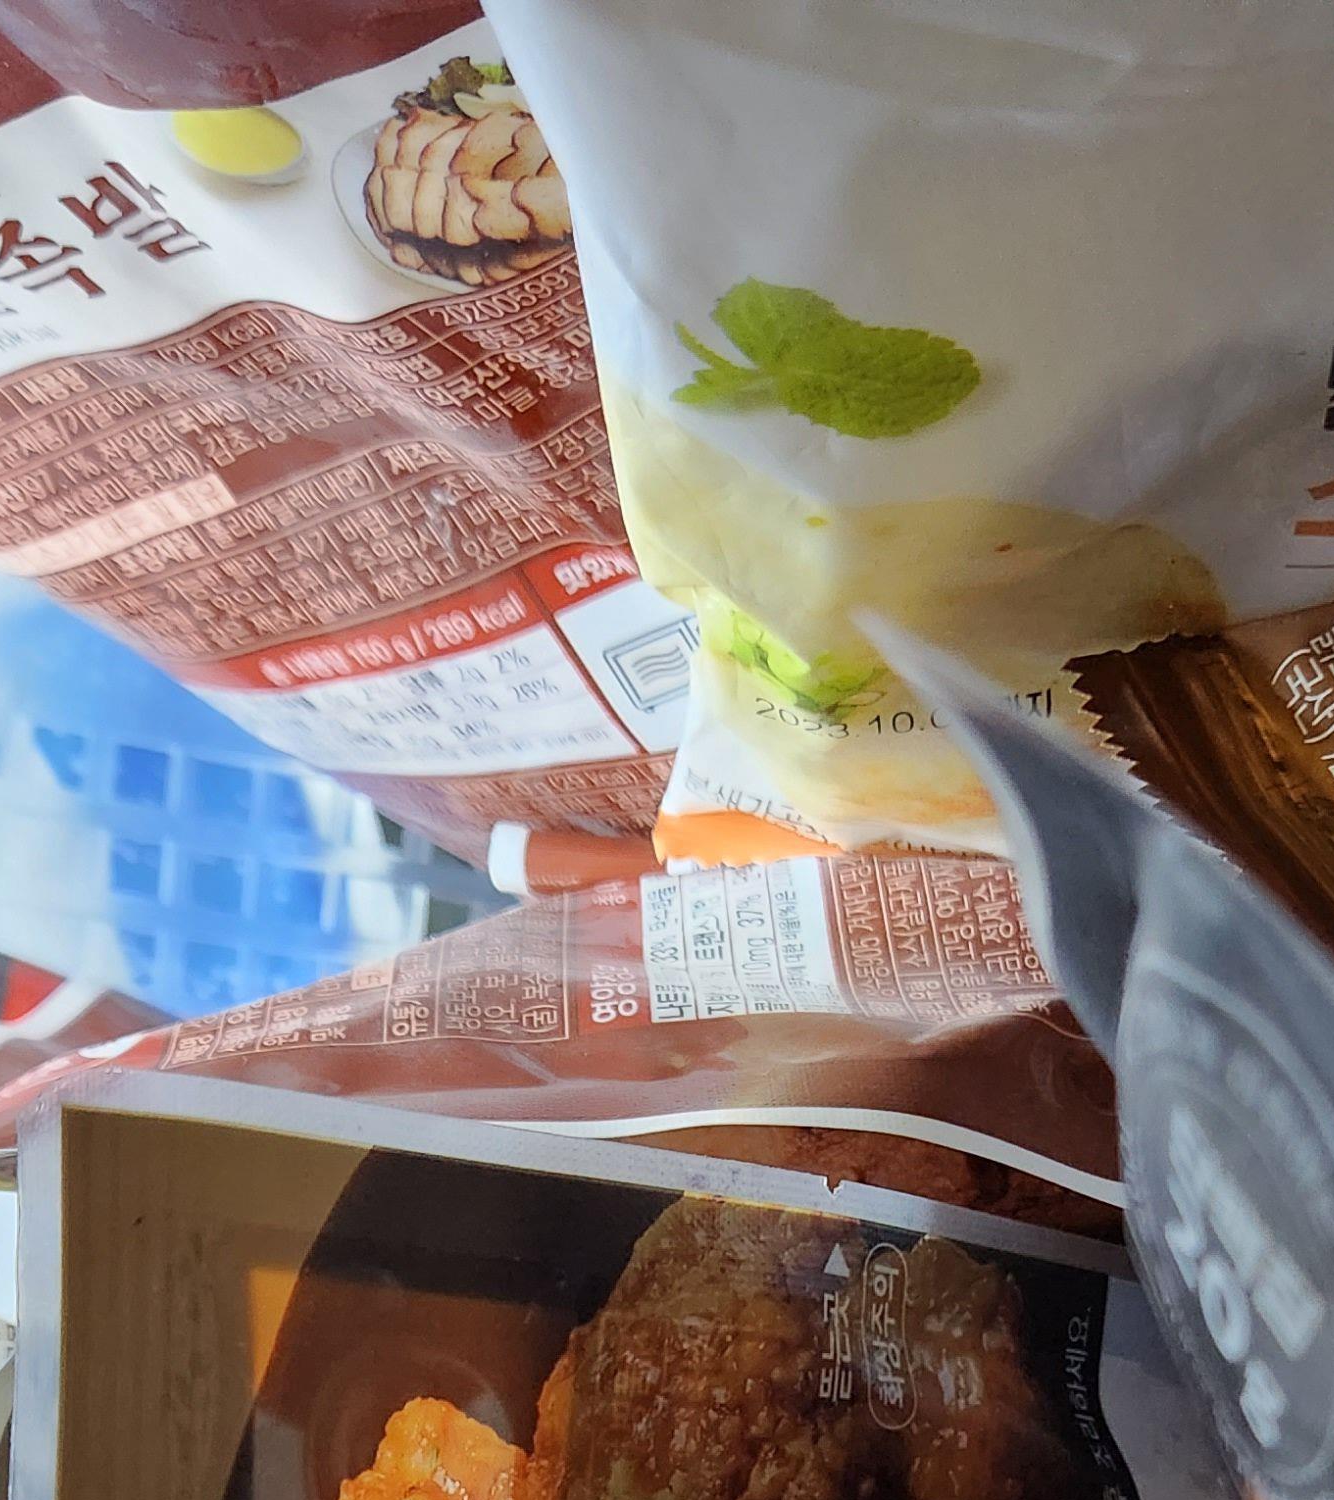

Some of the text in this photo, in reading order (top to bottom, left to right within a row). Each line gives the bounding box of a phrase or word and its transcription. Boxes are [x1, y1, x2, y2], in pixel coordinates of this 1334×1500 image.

[429, 262, 581, 328] 202005991
[210, 310, 276, 350] kcal)
[754, 695, 957, 741] 2023.10.0
[818, 1291, 854, 1404] 뜯는곳
[869, 1263, 906, 1408] 화상주의
